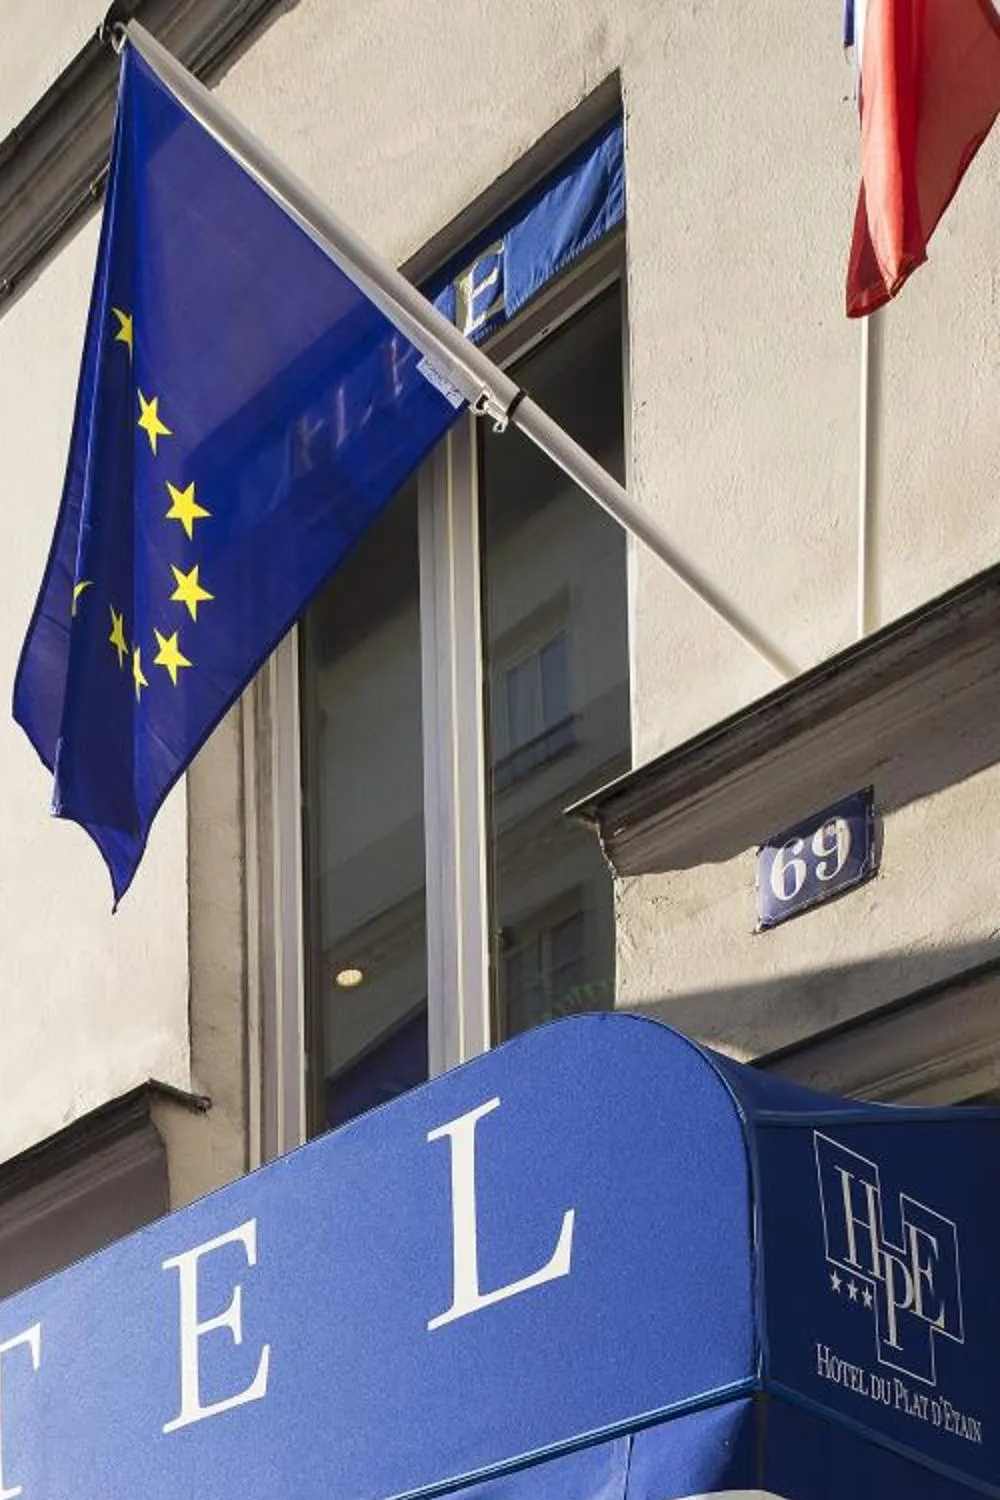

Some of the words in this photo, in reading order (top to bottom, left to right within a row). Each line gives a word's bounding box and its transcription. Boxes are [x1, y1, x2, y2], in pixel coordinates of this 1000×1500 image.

[770, 816, 851, 901] 69
[816, 1343, 869, 1395] HOTEL
[870, 1373, 891, 1405] DU
[893, 1377, 928, 1421] PLAT
